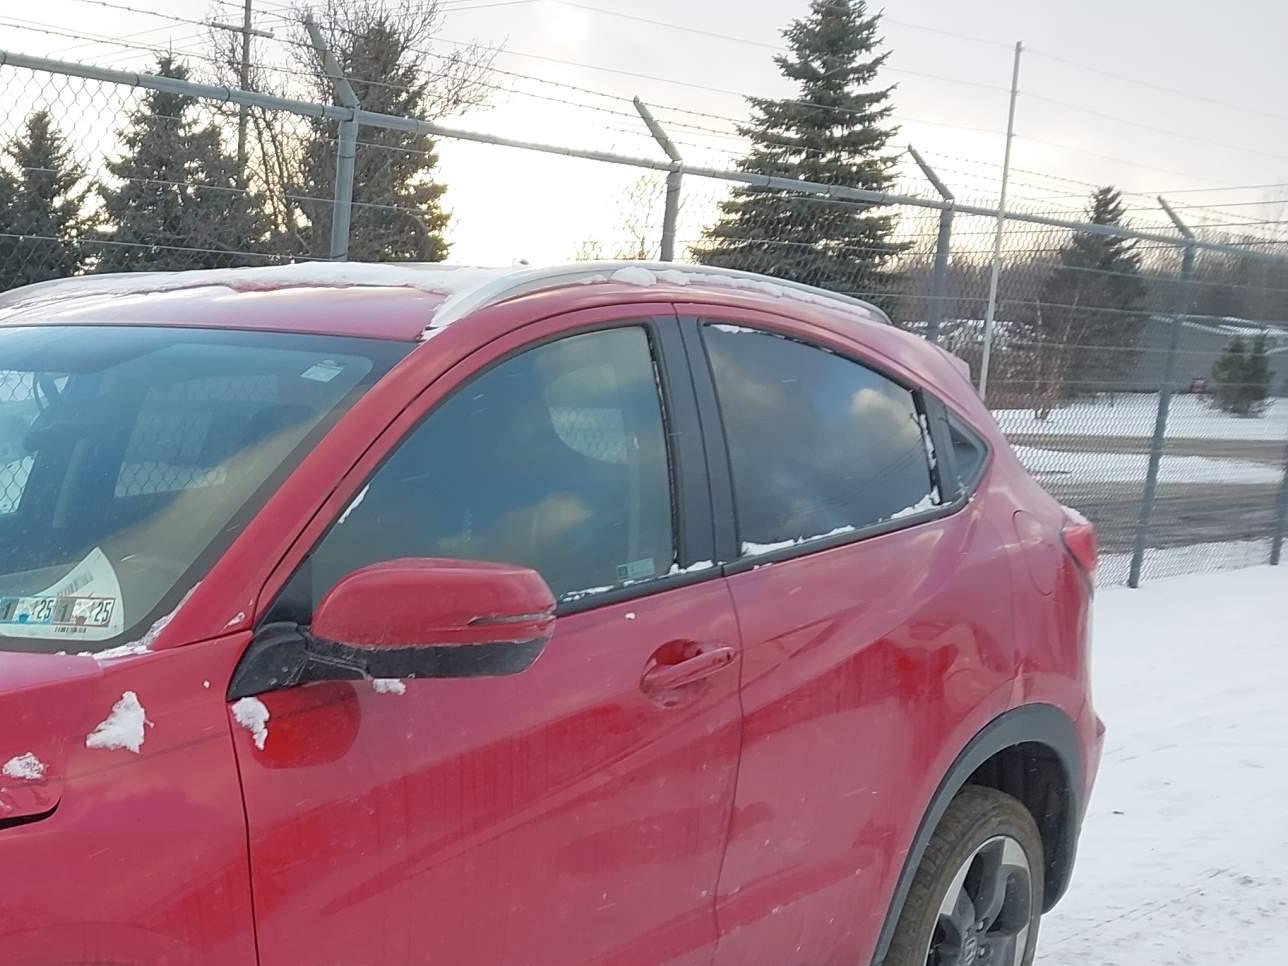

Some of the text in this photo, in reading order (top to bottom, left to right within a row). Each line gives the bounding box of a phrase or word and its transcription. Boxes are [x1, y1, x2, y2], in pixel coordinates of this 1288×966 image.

[4, 602, 12, 620] 1
[37, 600, 54, 620] 25
[94, 601, 111, 623] 25
